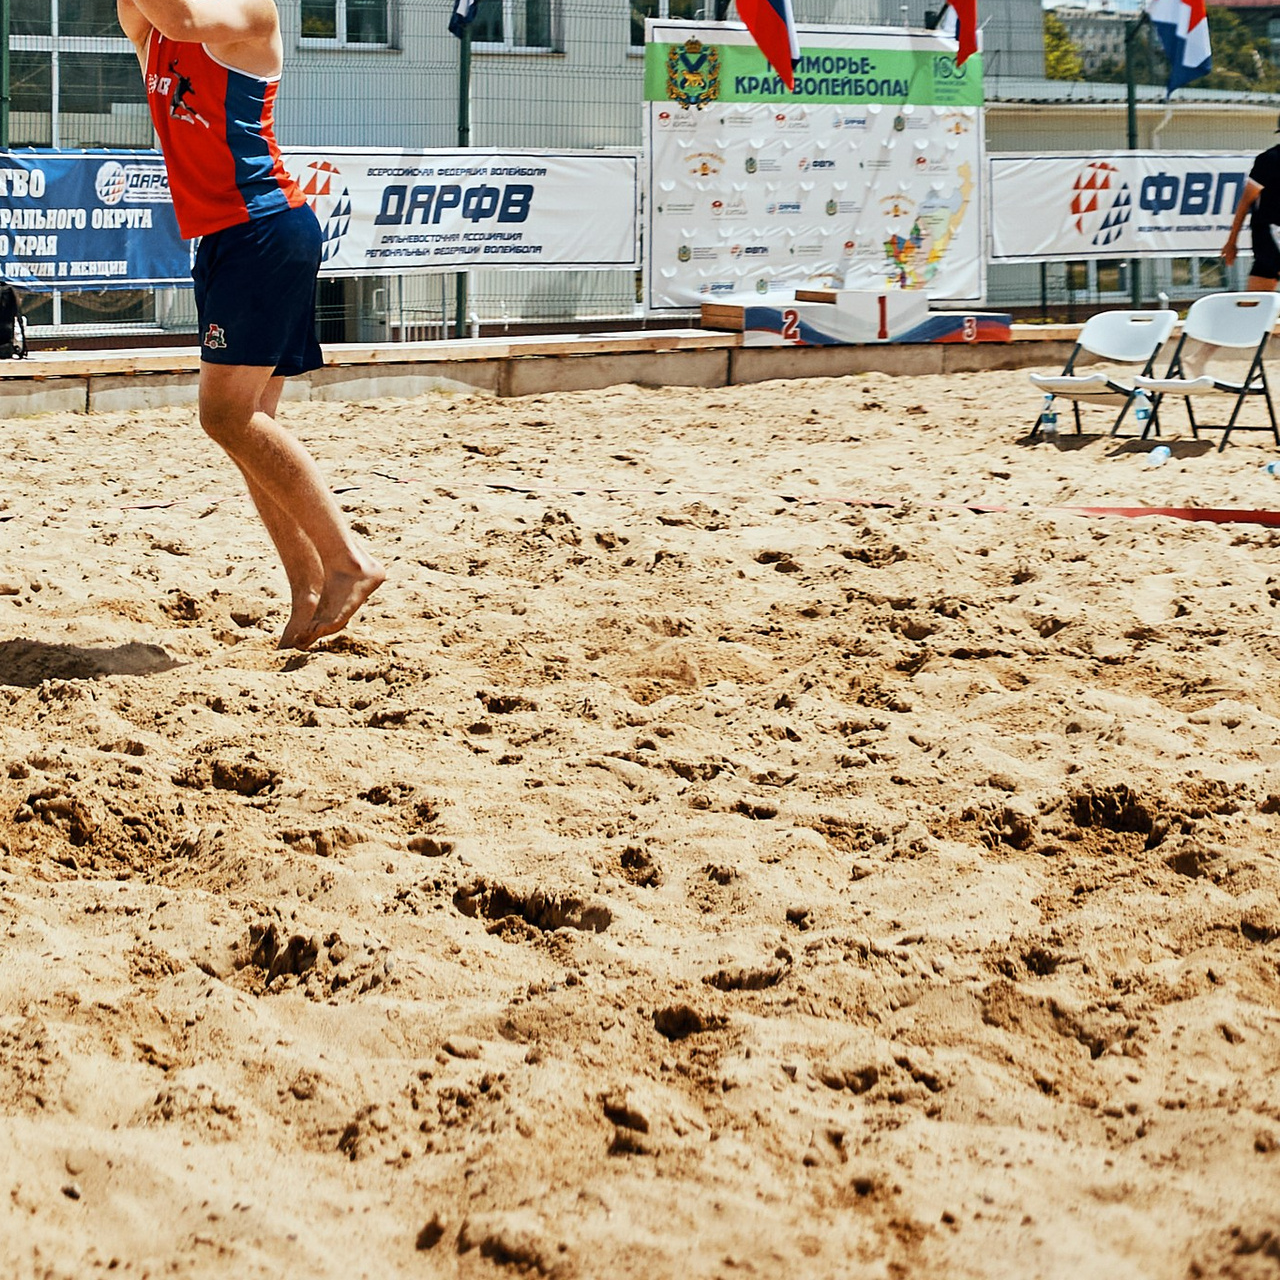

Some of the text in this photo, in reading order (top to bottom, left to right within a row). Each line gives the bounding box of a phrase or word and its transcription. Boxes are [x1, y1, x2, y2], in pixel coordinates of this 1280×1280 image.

[767, 55, 876, 75] ИМОРЬЕ-
[735, 74, 909, 97] КРАЙ ВОЛЕЙБОЛА!
[437, 167, 487, 176] ФЕДЕРАЦИЯ
[490, 166, 548, 176] ВОЛЕЙБОЛА
[374, 183, 534, 226] ДАРФВ
[1139, 171, 1250, 216] ФВП
[91, 208, 153, 229] ОКРУГА
[13, 235, 58, 257] КРАЯ
[381, 232, 523, 244] ДАЛЬНЕВОСТОЧНАЯ АССОЦИАЦИЯ
[483, 243, 543, 254] ВОЛЕЙБОЛА
[5, 262, 56, 277] МУЖЧИН
[58, 261, 68, 277] И
[70, 260, 128, 277] ЖЕНЩИН
[781, 308, 800, 341] 2
[877, 295, 889, 340] 1
[962, 317, 977, 340] 3
